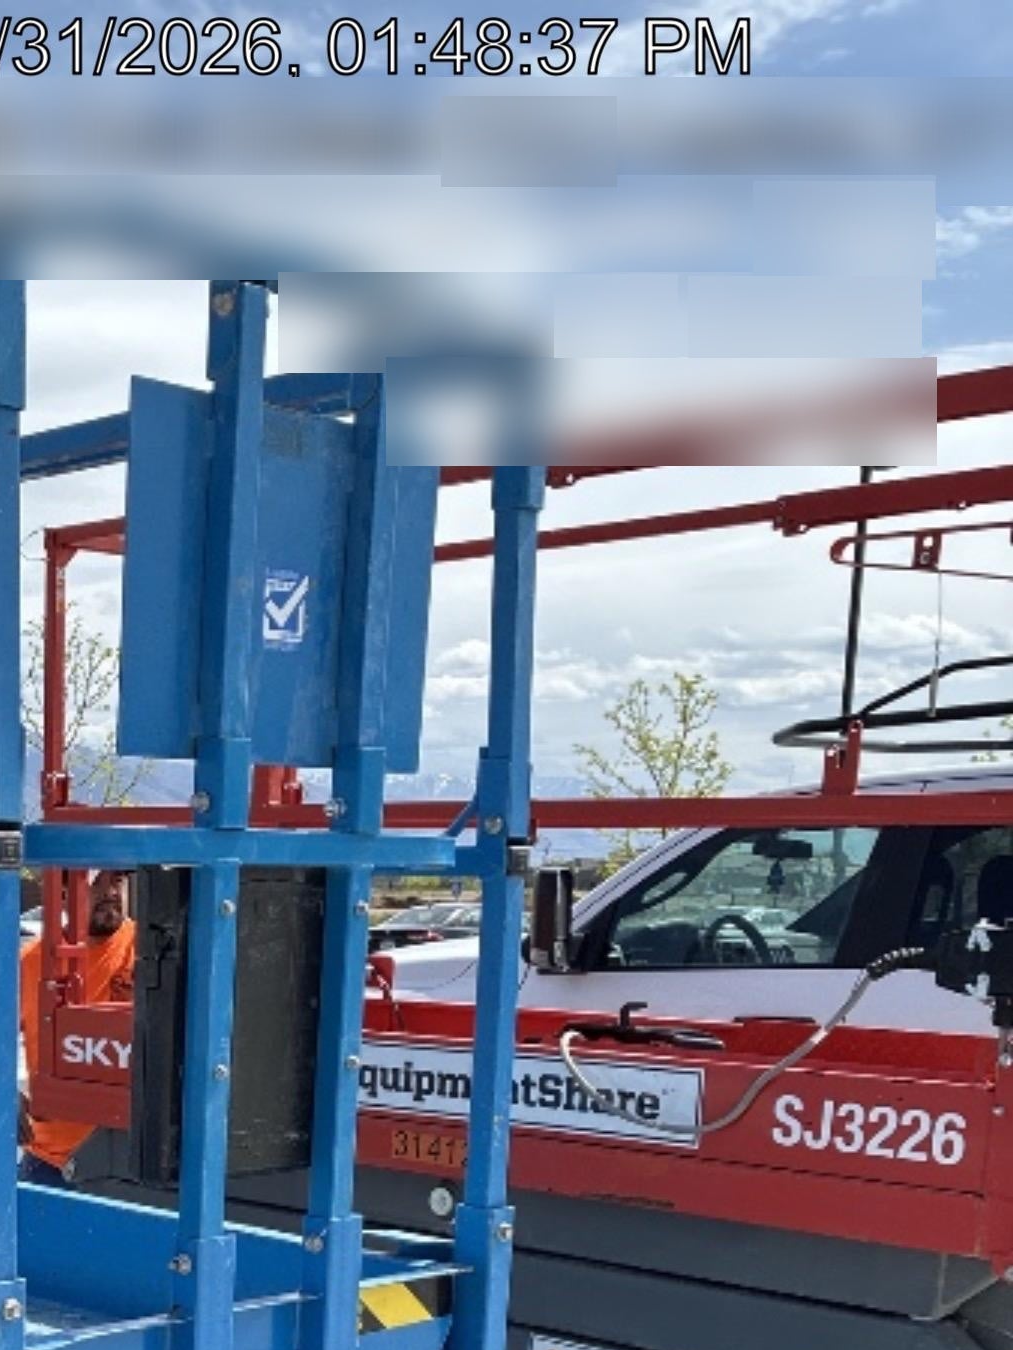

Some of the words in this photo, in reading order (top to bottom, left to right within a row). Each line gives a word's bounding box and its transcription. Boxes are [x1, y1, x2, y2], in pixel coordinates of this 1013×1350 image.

[62, 1034, 132, 1069] SKY
[359, 1061, 660, 1120] quipmtShare
[772, 1094, 966, 1165] SJ3226
